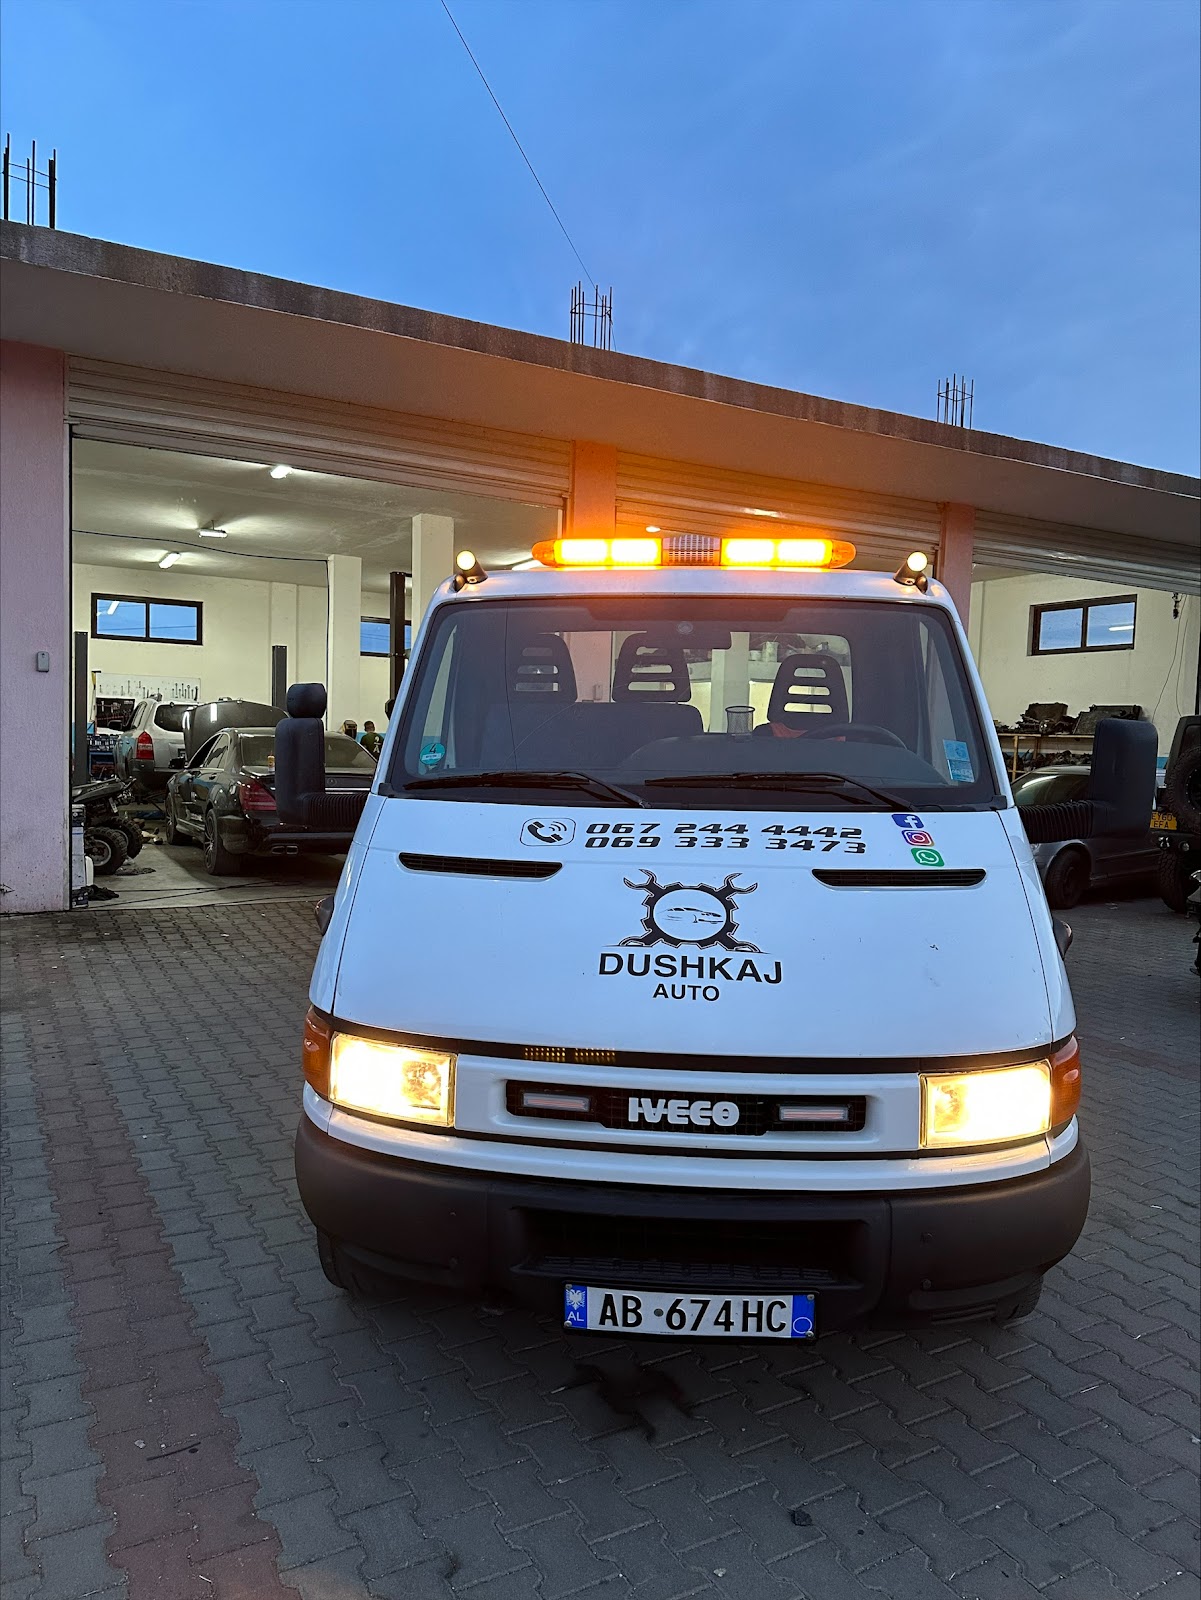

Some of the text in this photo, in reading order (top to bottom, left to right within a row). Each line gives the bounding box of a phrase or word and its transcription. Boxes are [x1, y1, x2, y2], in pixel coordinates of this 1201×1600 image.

[585, 823, 862, 840] 067 244 4442
[1153, 820, 1169, 828] EFA
[584, 836, 867, 854] 069 333 3473
[598, 952, 782, 985] DUSHKAJ
[652, 983, 720, 1002] AUTO
[627, 1096, 740, 1127] IVECO
[567, 1311, 585, 1323] AL
[598, 1293, 788, 1333] AB 674HC
